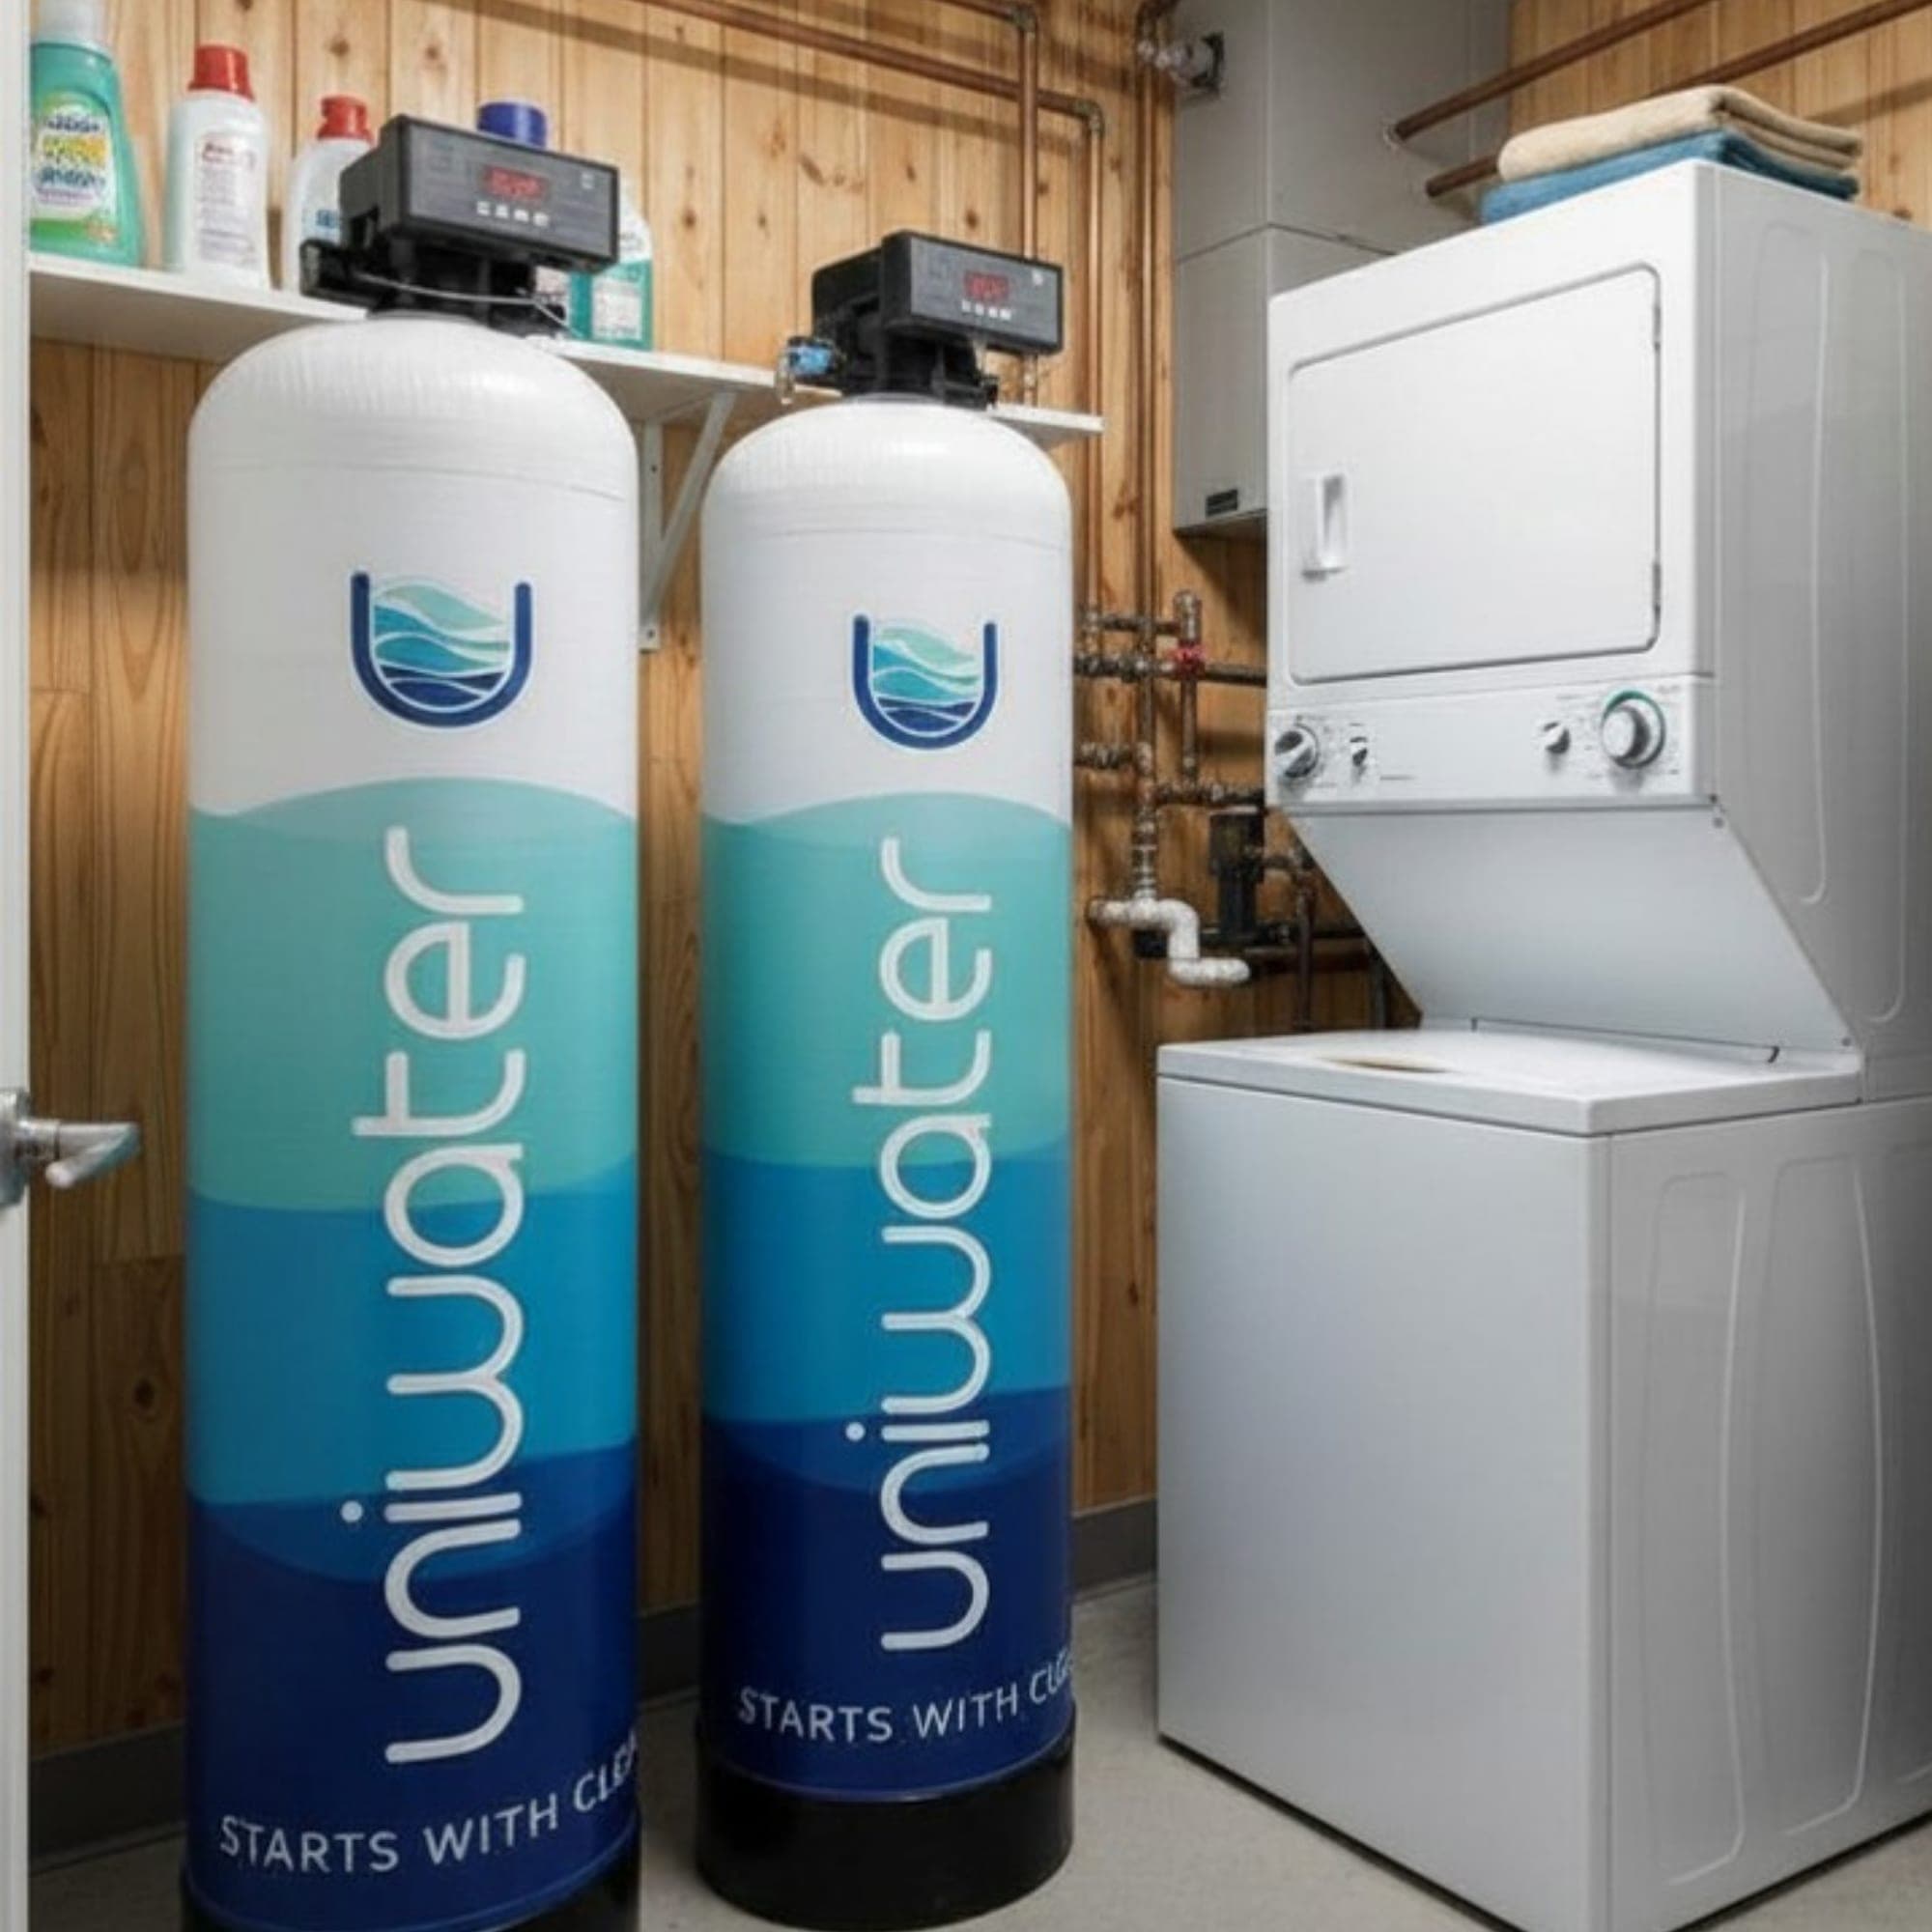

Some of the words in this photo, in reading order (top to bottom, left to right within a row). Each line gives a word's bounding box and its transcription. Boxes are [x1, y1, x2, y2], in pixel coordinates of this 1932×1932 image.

[341, 826, 527, 1765] uniwater
[845, 836, 993, 1652] uniwater
[220, 1815, 399, 1873] STARTS
[423, 1792, 558, 1866] WITH
[736, 1685, 895, 1744] STARTS
[912, 1680, 1018, 1739] WITH
